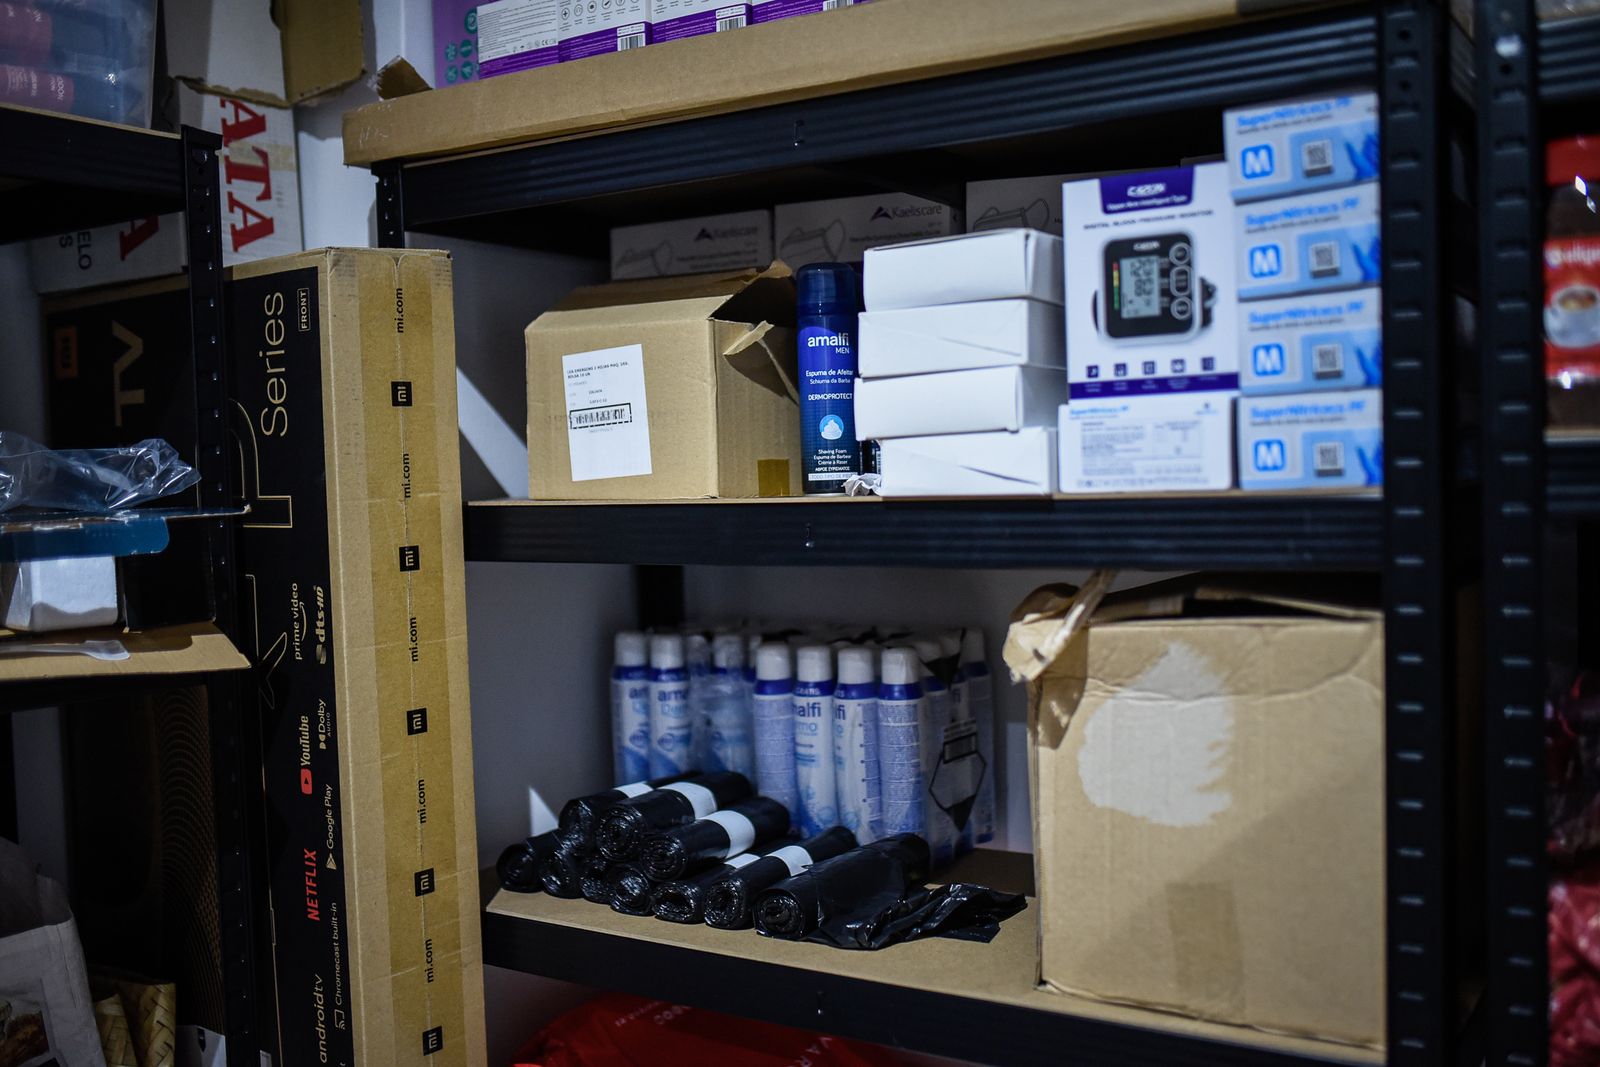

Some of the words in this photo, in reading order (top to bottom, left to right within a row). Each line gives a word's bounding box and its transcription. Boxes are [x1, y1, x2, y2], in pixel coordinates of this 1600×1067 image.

[1243, 147, 1272, 176] M
[1251, 246, 1280, 276] M
[300, 290, 308, 329] FRONT
[395, 287, 404, 333] mi.com
[807, 332, 850, 347] amalfi
[258, 291, 289, 437] Series
[806, 370, 828, 378] Espuma
[1256, 346, 1283, 374] M
[808, 392, 853, 401] DERMOPROTECT
[1256, 442, 1283, 470] M
[401, 453, 411, 499] mi.com
[291, 582, 299, 618] video
[292, 621, 303, 661] prime
[409, 616, 419, 662] mi.com
[317, 699, 327, 733] Dolby
[298, 715, 312, 767] YouTube
[324, 783, 334, 807] Play
[417, 779, 427, 824] mi.com
[325, 809, 335, 850] Google
[303, 848, 321, 921] NETFLIX
[330, 902, 339, 940] built-in
[333, 942, 342, 1006] Chromecast
[424, 938, 434, 983] mi.com
